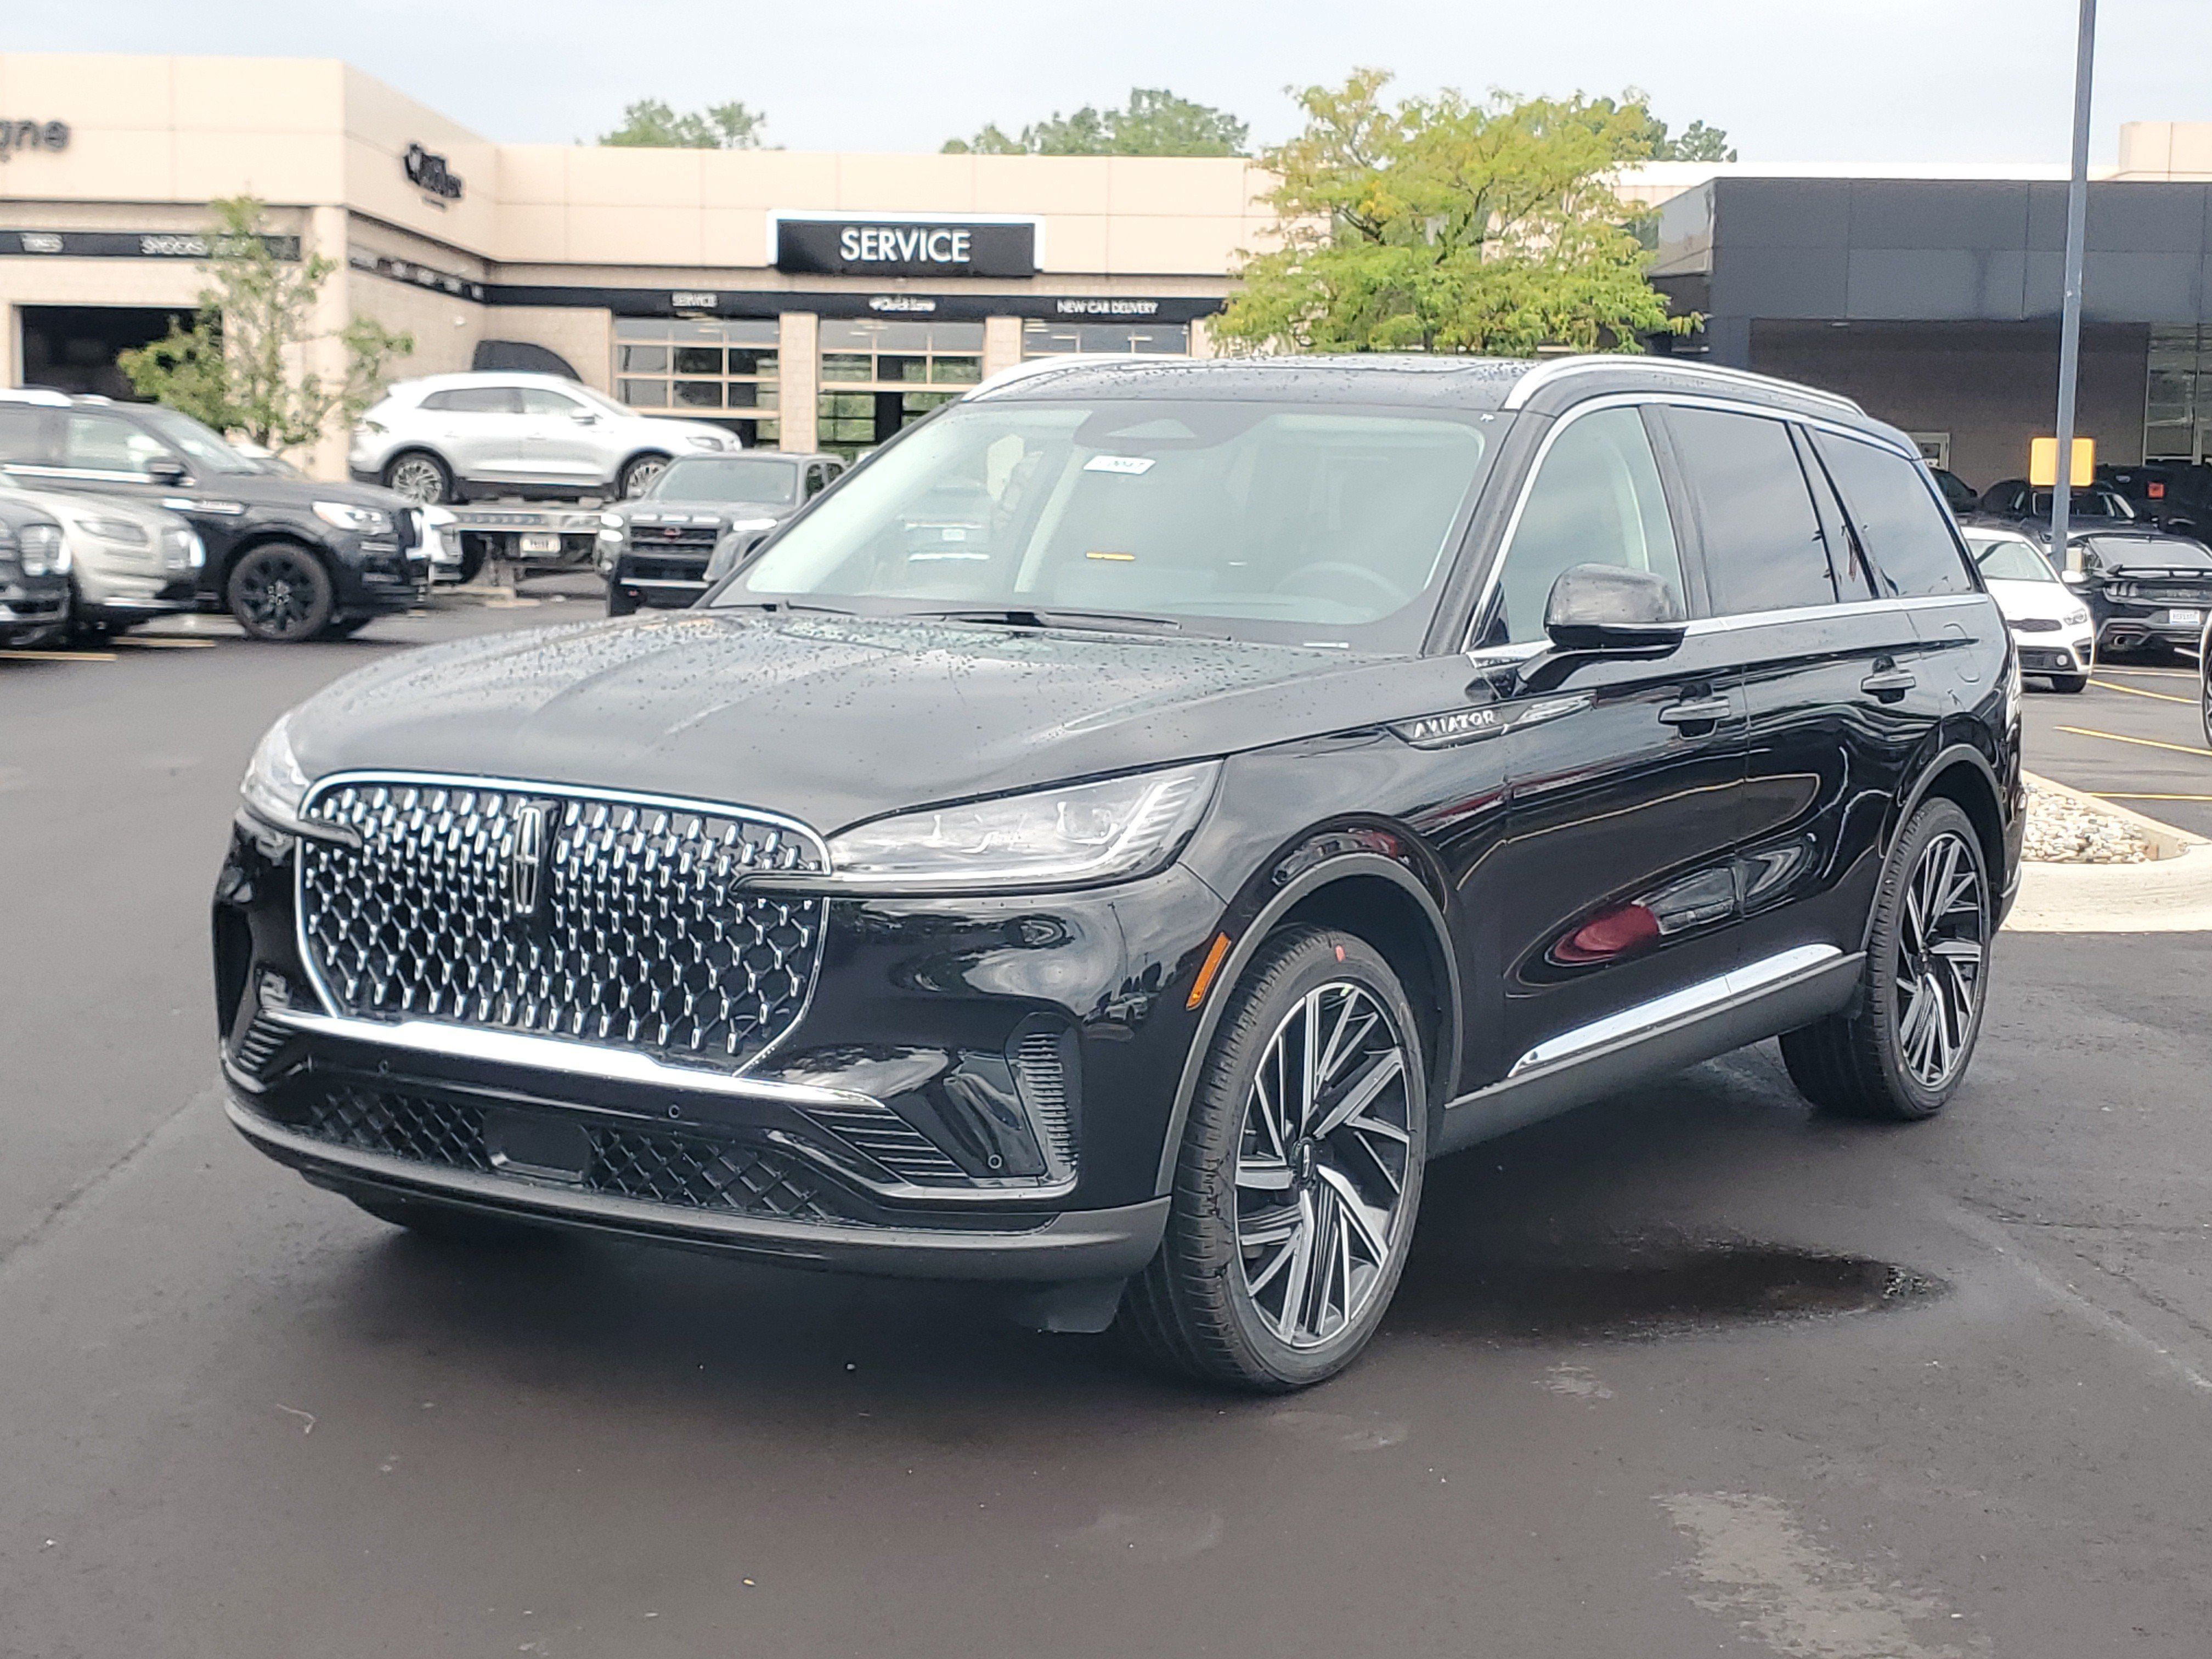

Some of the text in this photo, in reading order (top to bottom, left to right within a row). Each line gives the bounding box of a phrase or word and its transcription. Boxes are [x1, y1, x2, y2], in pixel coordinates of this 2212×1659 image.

[839, 227, 971, 263] SERVICE
[1057, 299, 1159, 314] NEW CAR DELIVERY
[1413, 710, 1495, 738] AVIATOR
